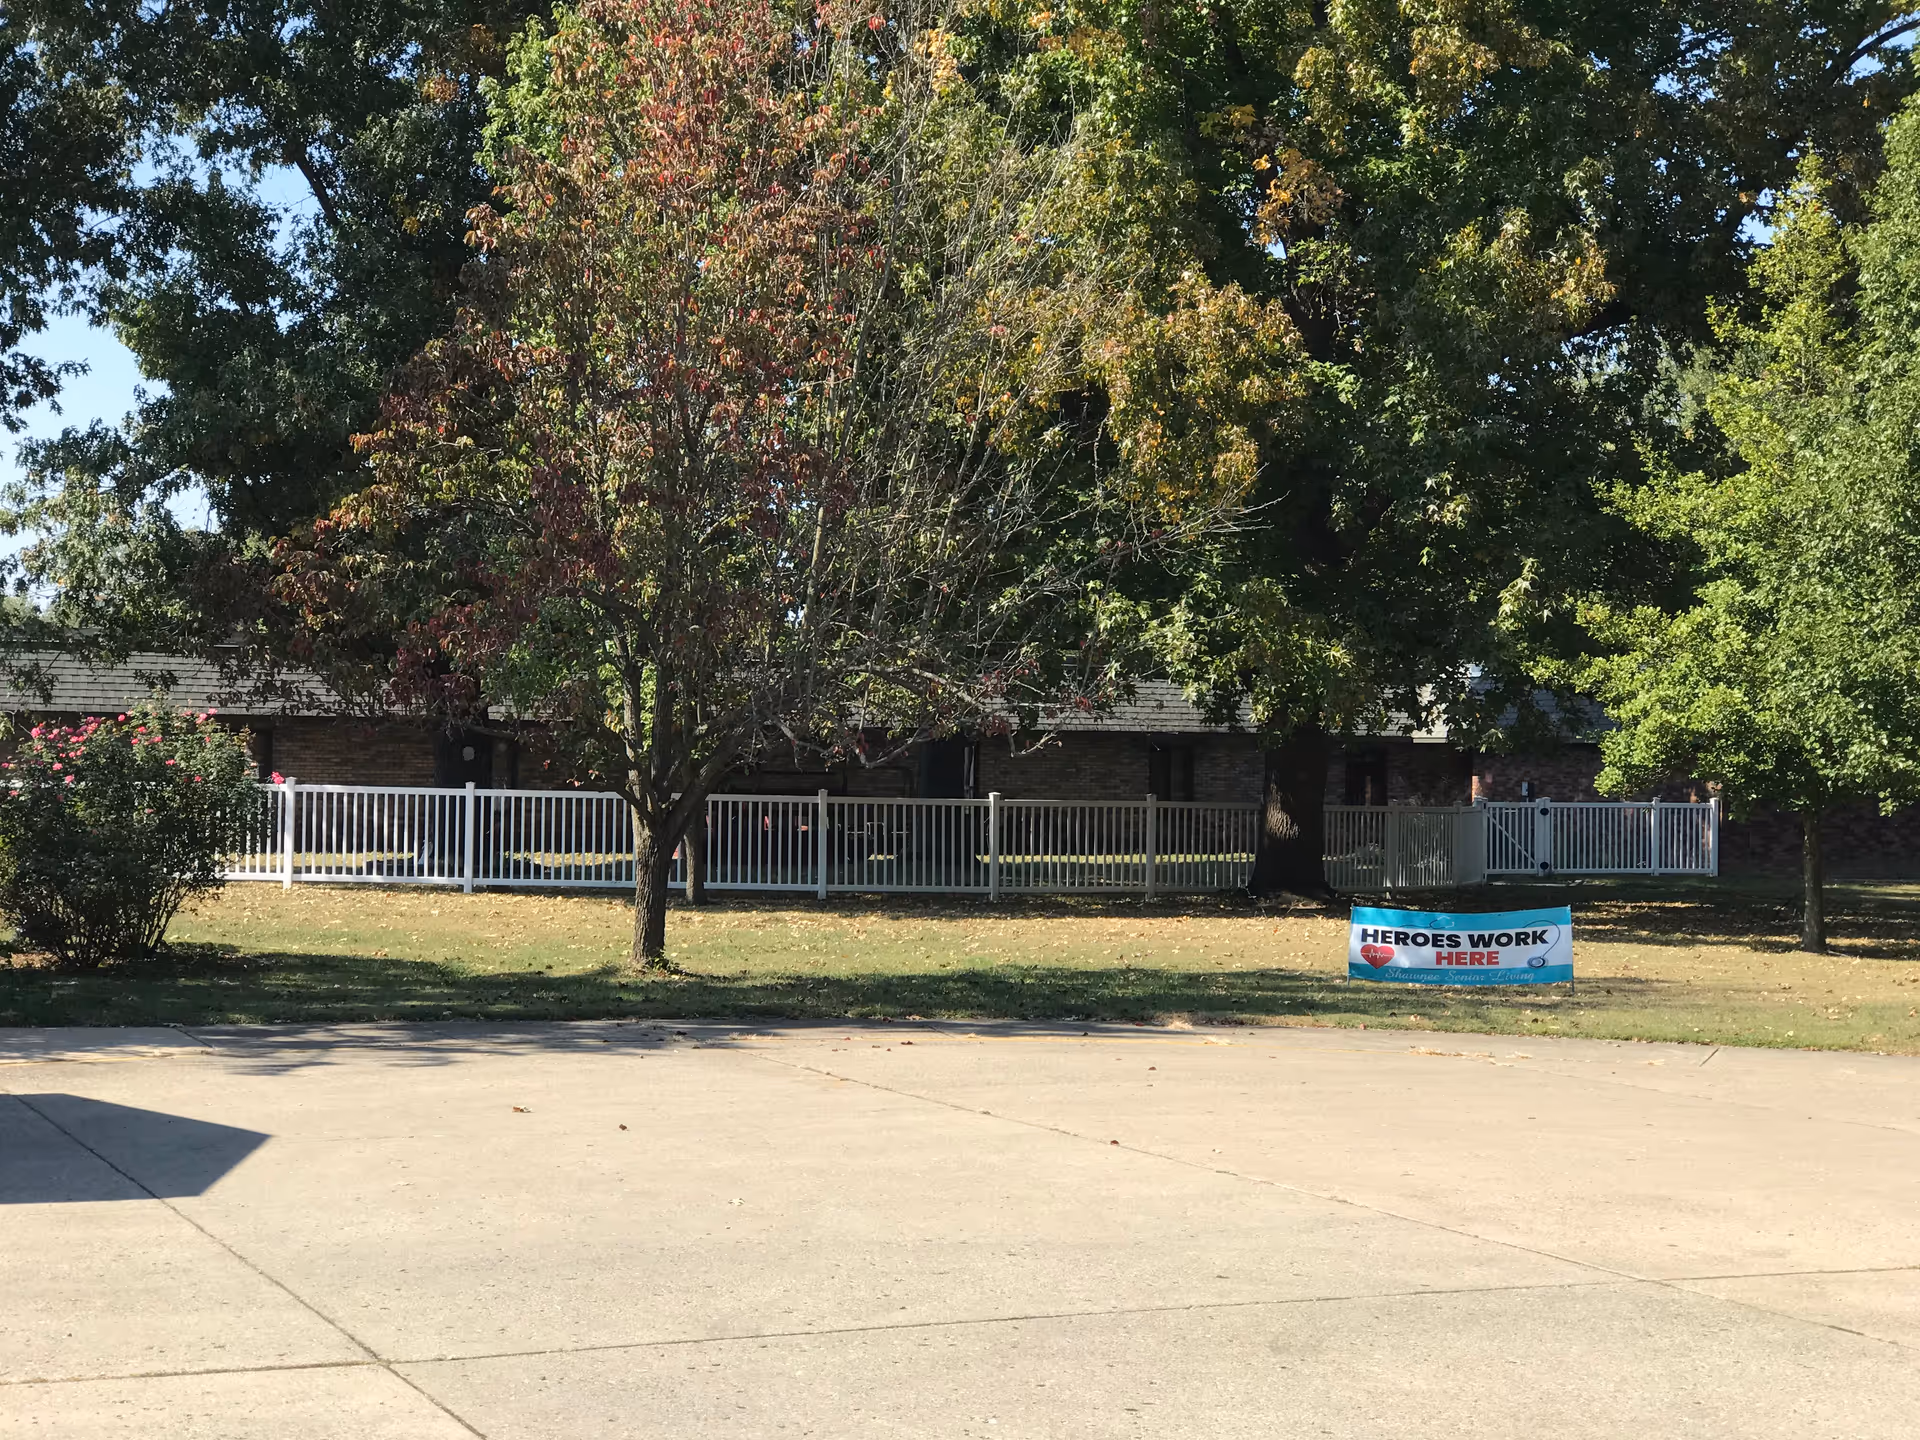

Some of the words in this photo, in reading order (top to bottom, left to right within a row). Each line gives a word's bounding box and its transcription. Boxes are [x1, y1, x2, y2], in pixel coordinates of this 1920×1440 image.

[1361, 928, 1461, 948] HEROES
[1467, 929, 1549, 948] WORK
[1435, 951, 1500, 966] HERE
[1444, 969, 1485, 982] Senior
[1489, 969, 1535, 982] Living
